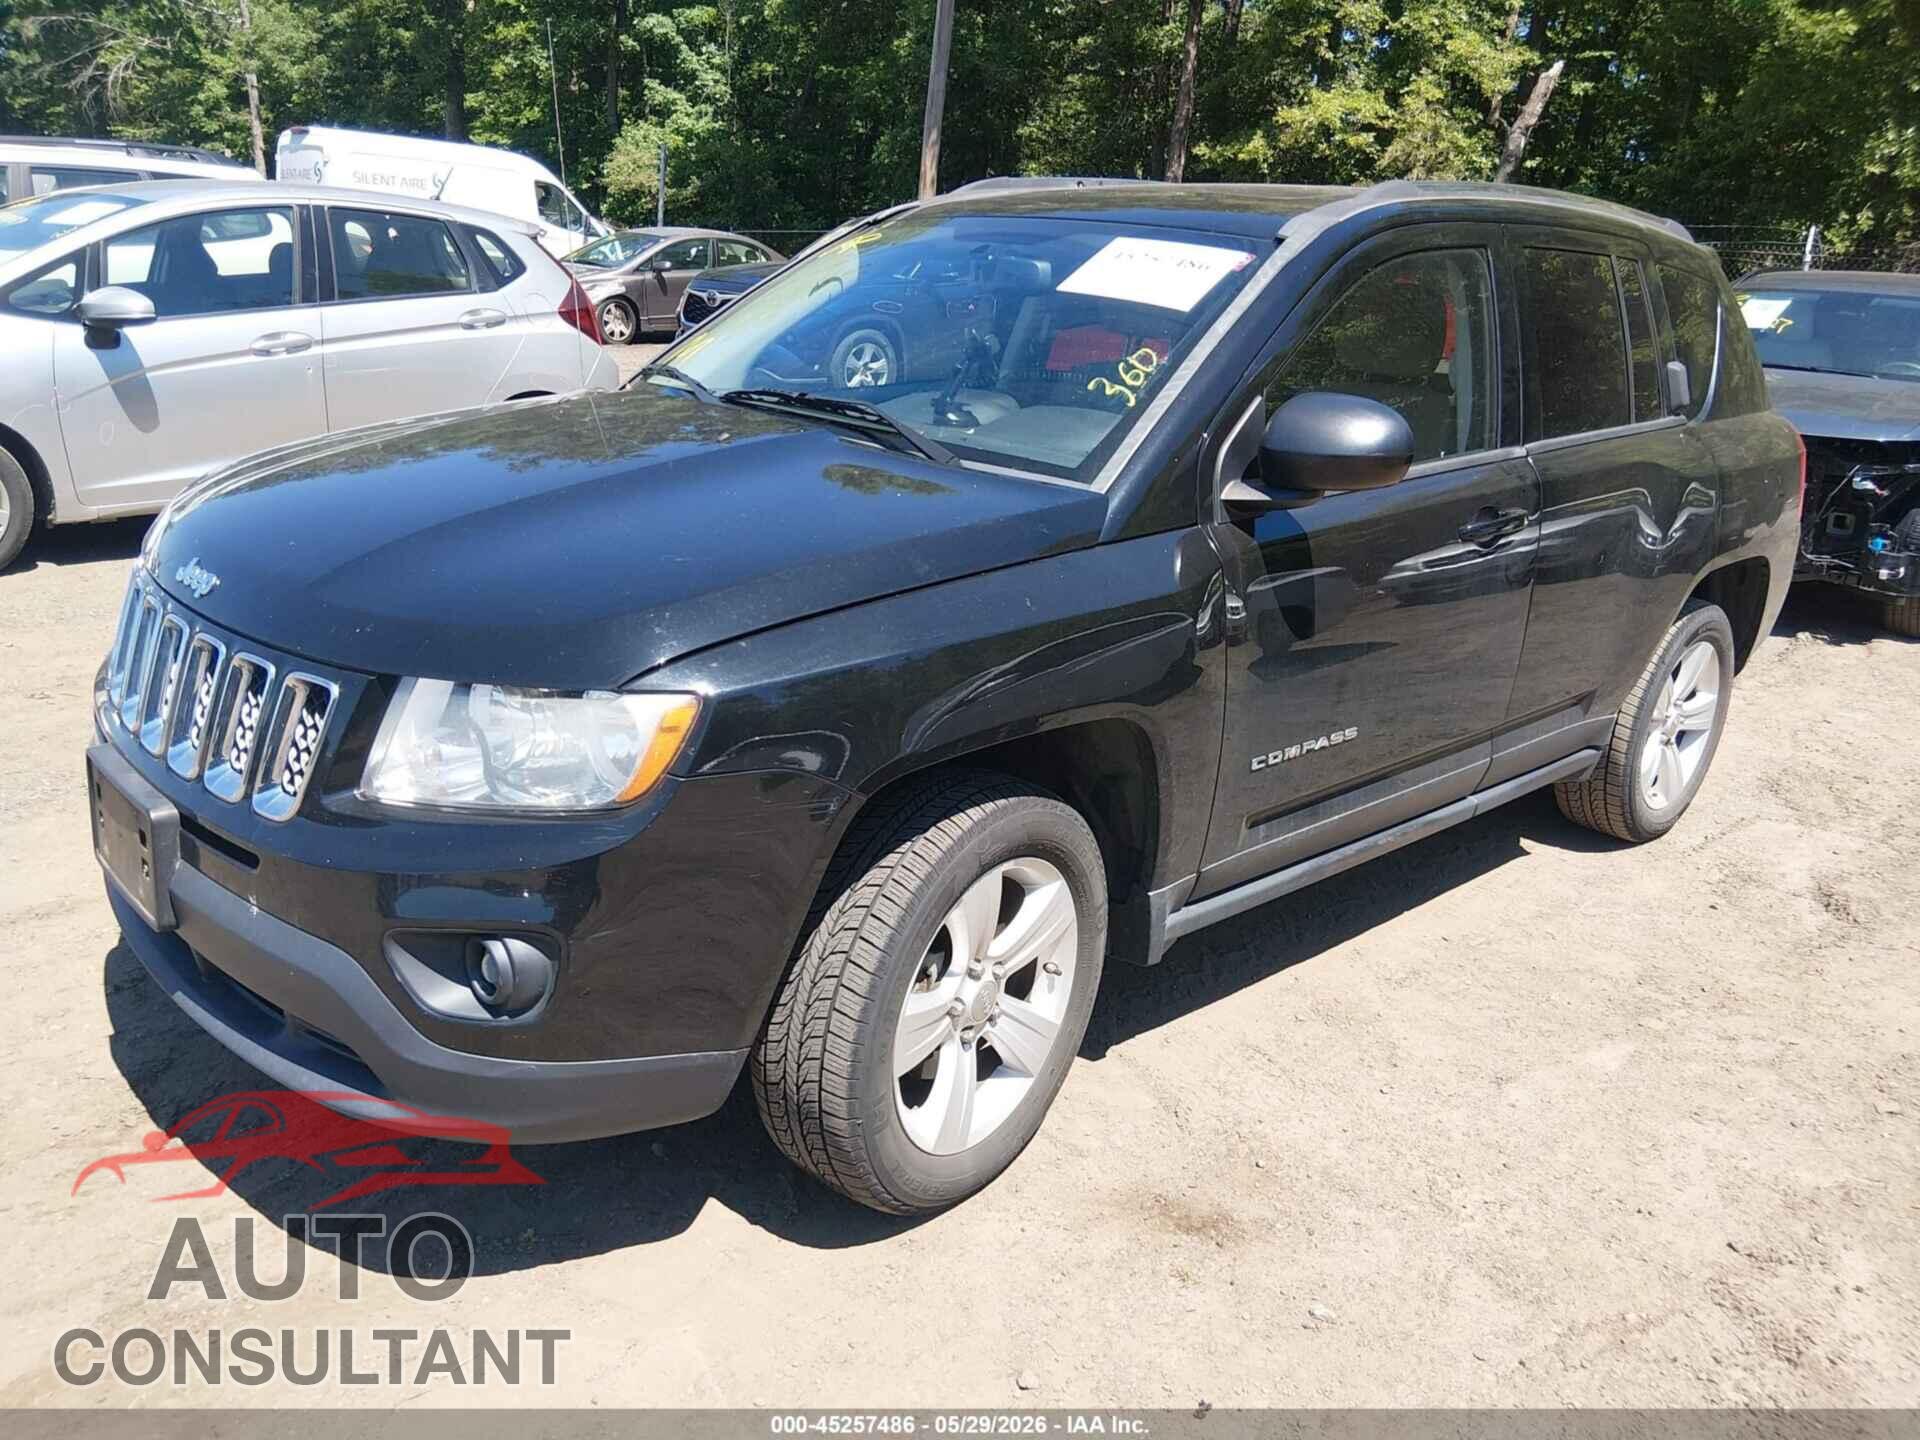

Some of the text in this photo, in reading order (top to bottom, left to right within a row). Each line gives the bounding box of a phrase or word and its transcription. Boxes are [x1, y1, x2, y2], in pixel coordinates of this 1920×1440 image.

[352, 169, 427, 191] SILENT AIRE
[1251, 726, 1358, 771] COMPASS
